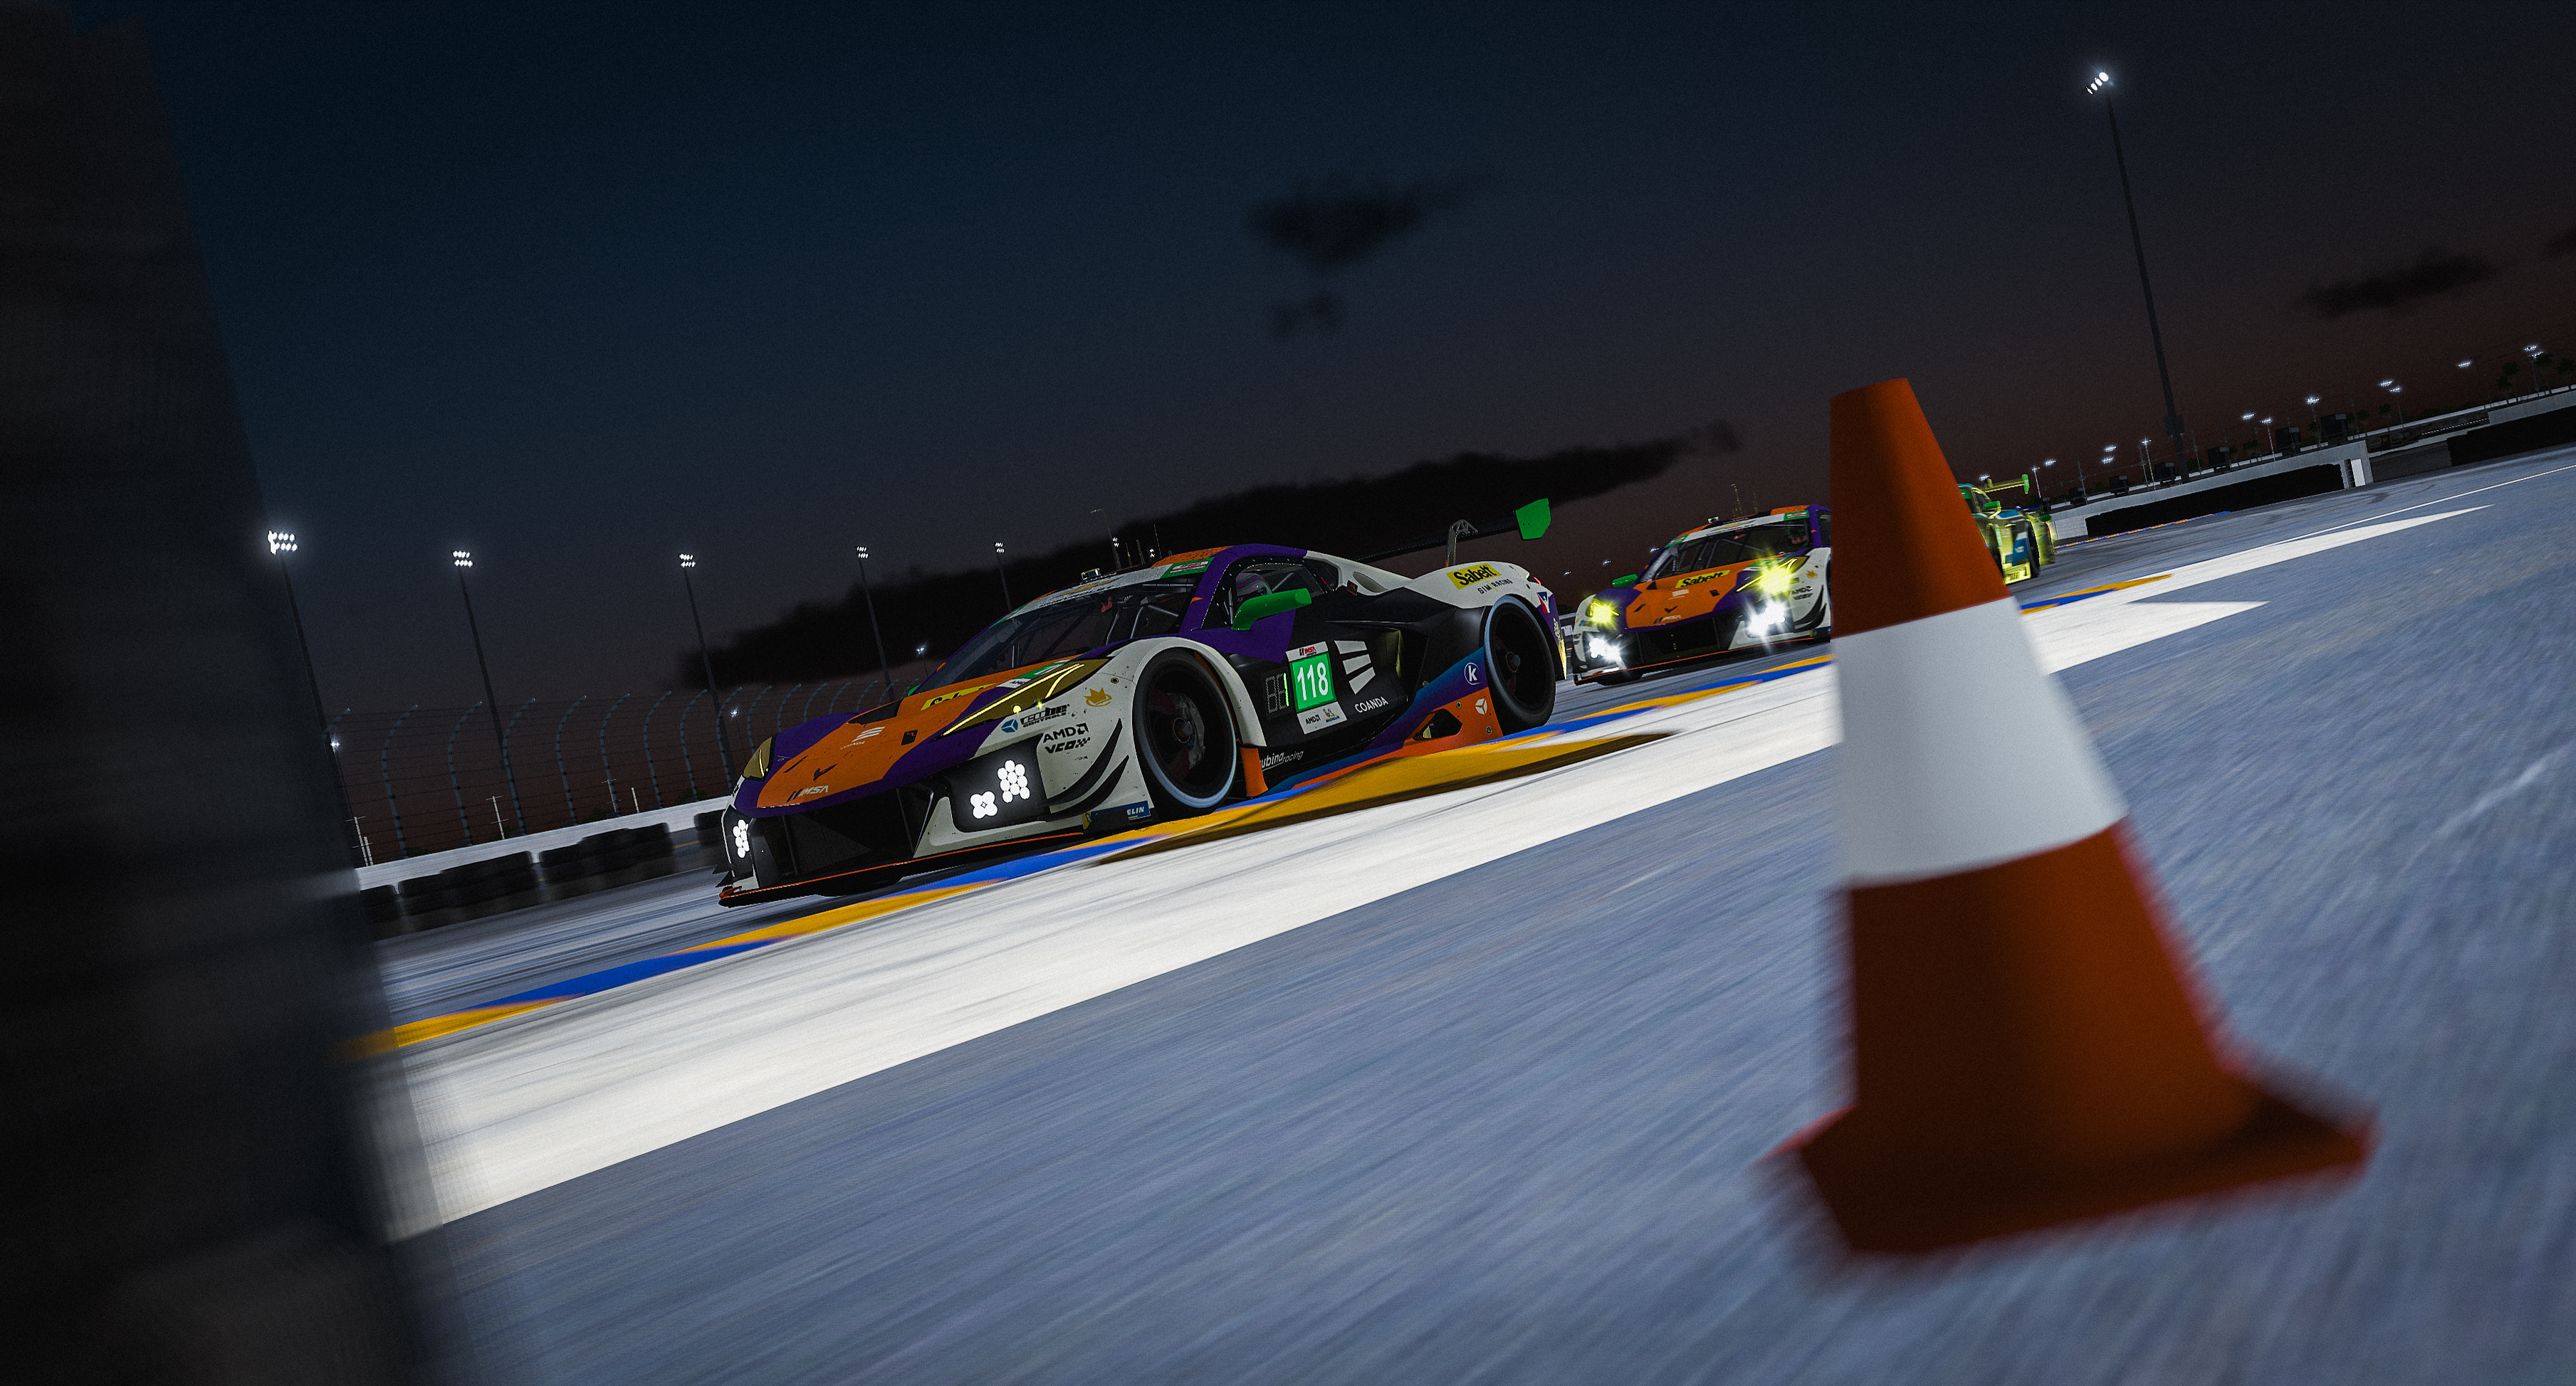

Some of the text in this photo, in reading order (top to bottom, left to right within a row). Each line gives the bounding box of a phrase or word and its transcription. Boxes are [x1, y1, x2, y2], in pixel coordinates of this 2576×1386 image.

[1454, 565, 1497, 586] Sabelt
[1680, 572, 1724, 587] Sabelt
[1477, 584, 1493, 594] SIM
[1297, 662, 1329, 701] 118
[1354, 696, 1389, 713] COANDA
[1043, 727, 1077, 743] AMD
[1260, 752, 1284, 769] ubina
[798, 785, 829, 797] IMSA
[1126, 806, 1145, 816] ELIN
